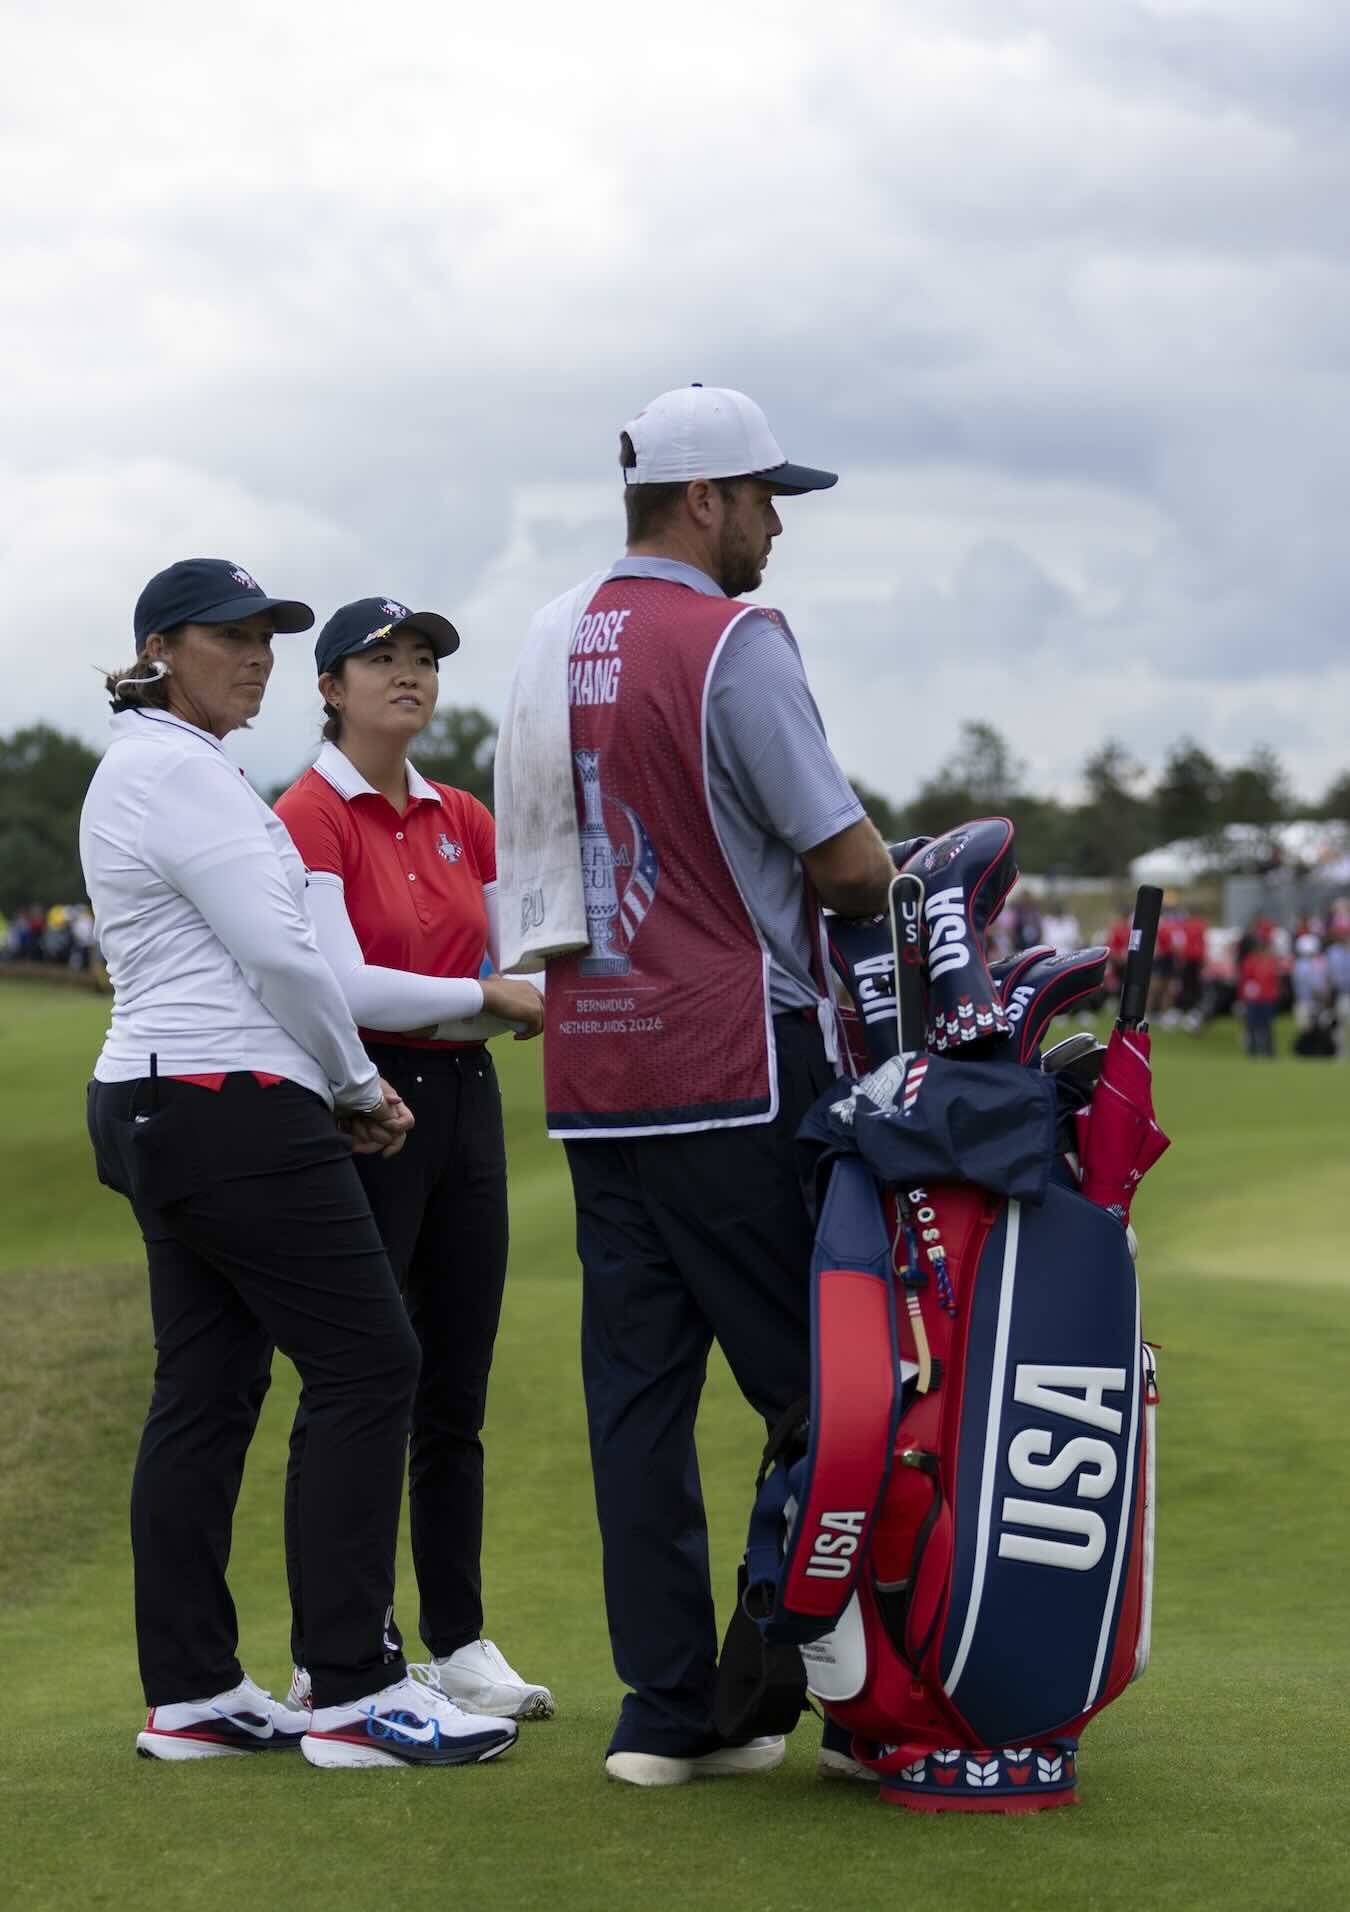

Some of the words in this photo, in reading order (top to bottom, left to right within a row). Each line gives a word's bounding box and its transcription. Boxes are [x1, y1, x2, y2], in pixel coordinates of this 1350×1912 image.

[571, 610, 631, 655] ROSE
[568, 657, 622, 704] HANG
[925, 886, 970, 983] USA
[1005, 986, 1036, 1039] SA
[908, 1187, 945, 1262] ROSE
[998, 1364, 1126, 1572] USA
[805, 1511, 867, 1579] USA
